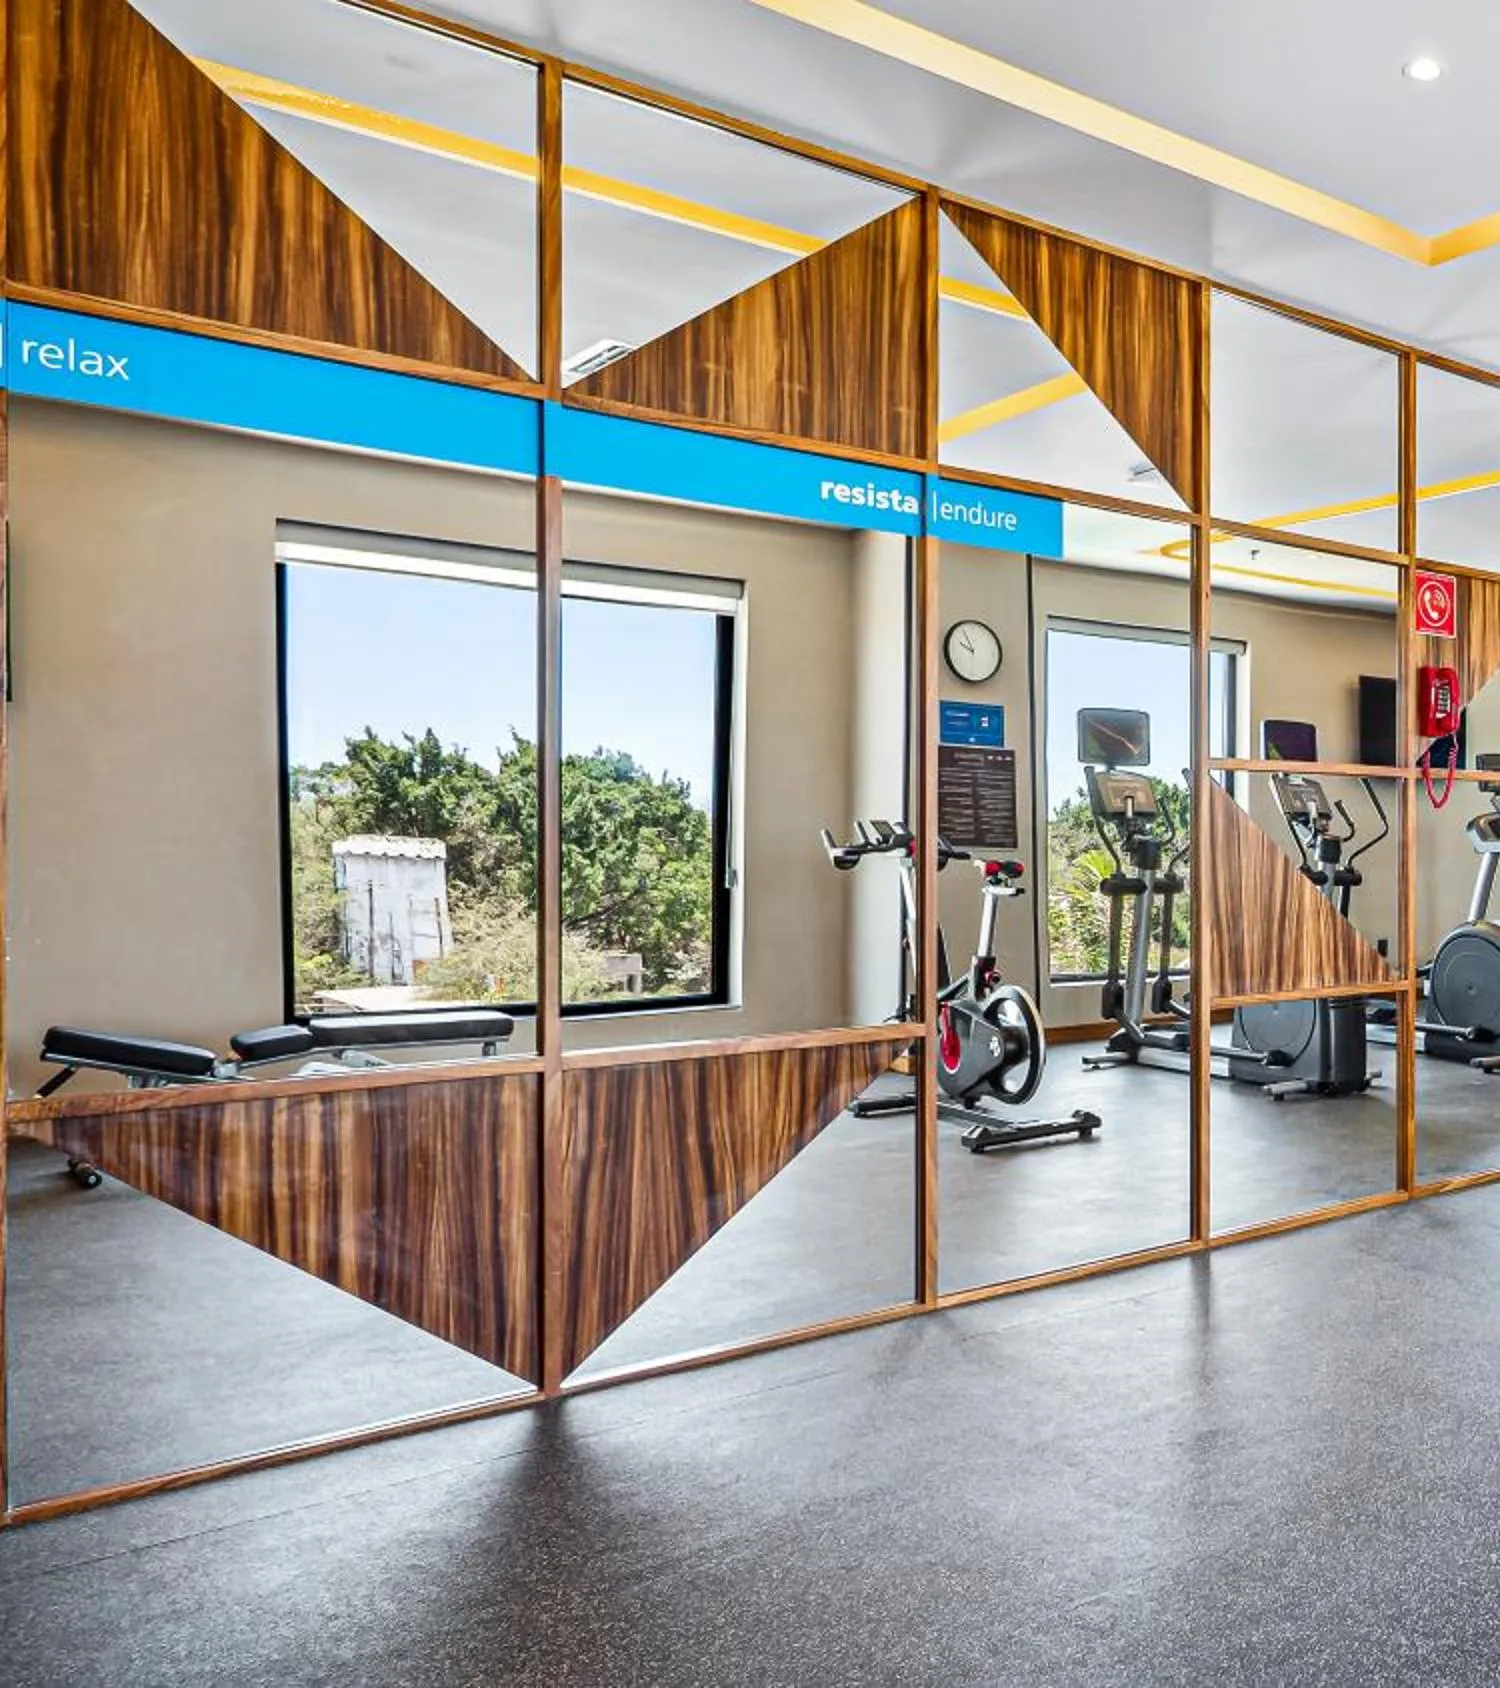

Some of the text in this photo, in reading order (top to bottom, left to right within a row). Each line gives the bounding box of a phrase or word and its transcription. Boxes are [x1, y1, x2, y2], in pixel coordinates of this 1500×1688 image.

[22, 337, 129, 380] relax
[820, 480, 1017, 532] resista endure
